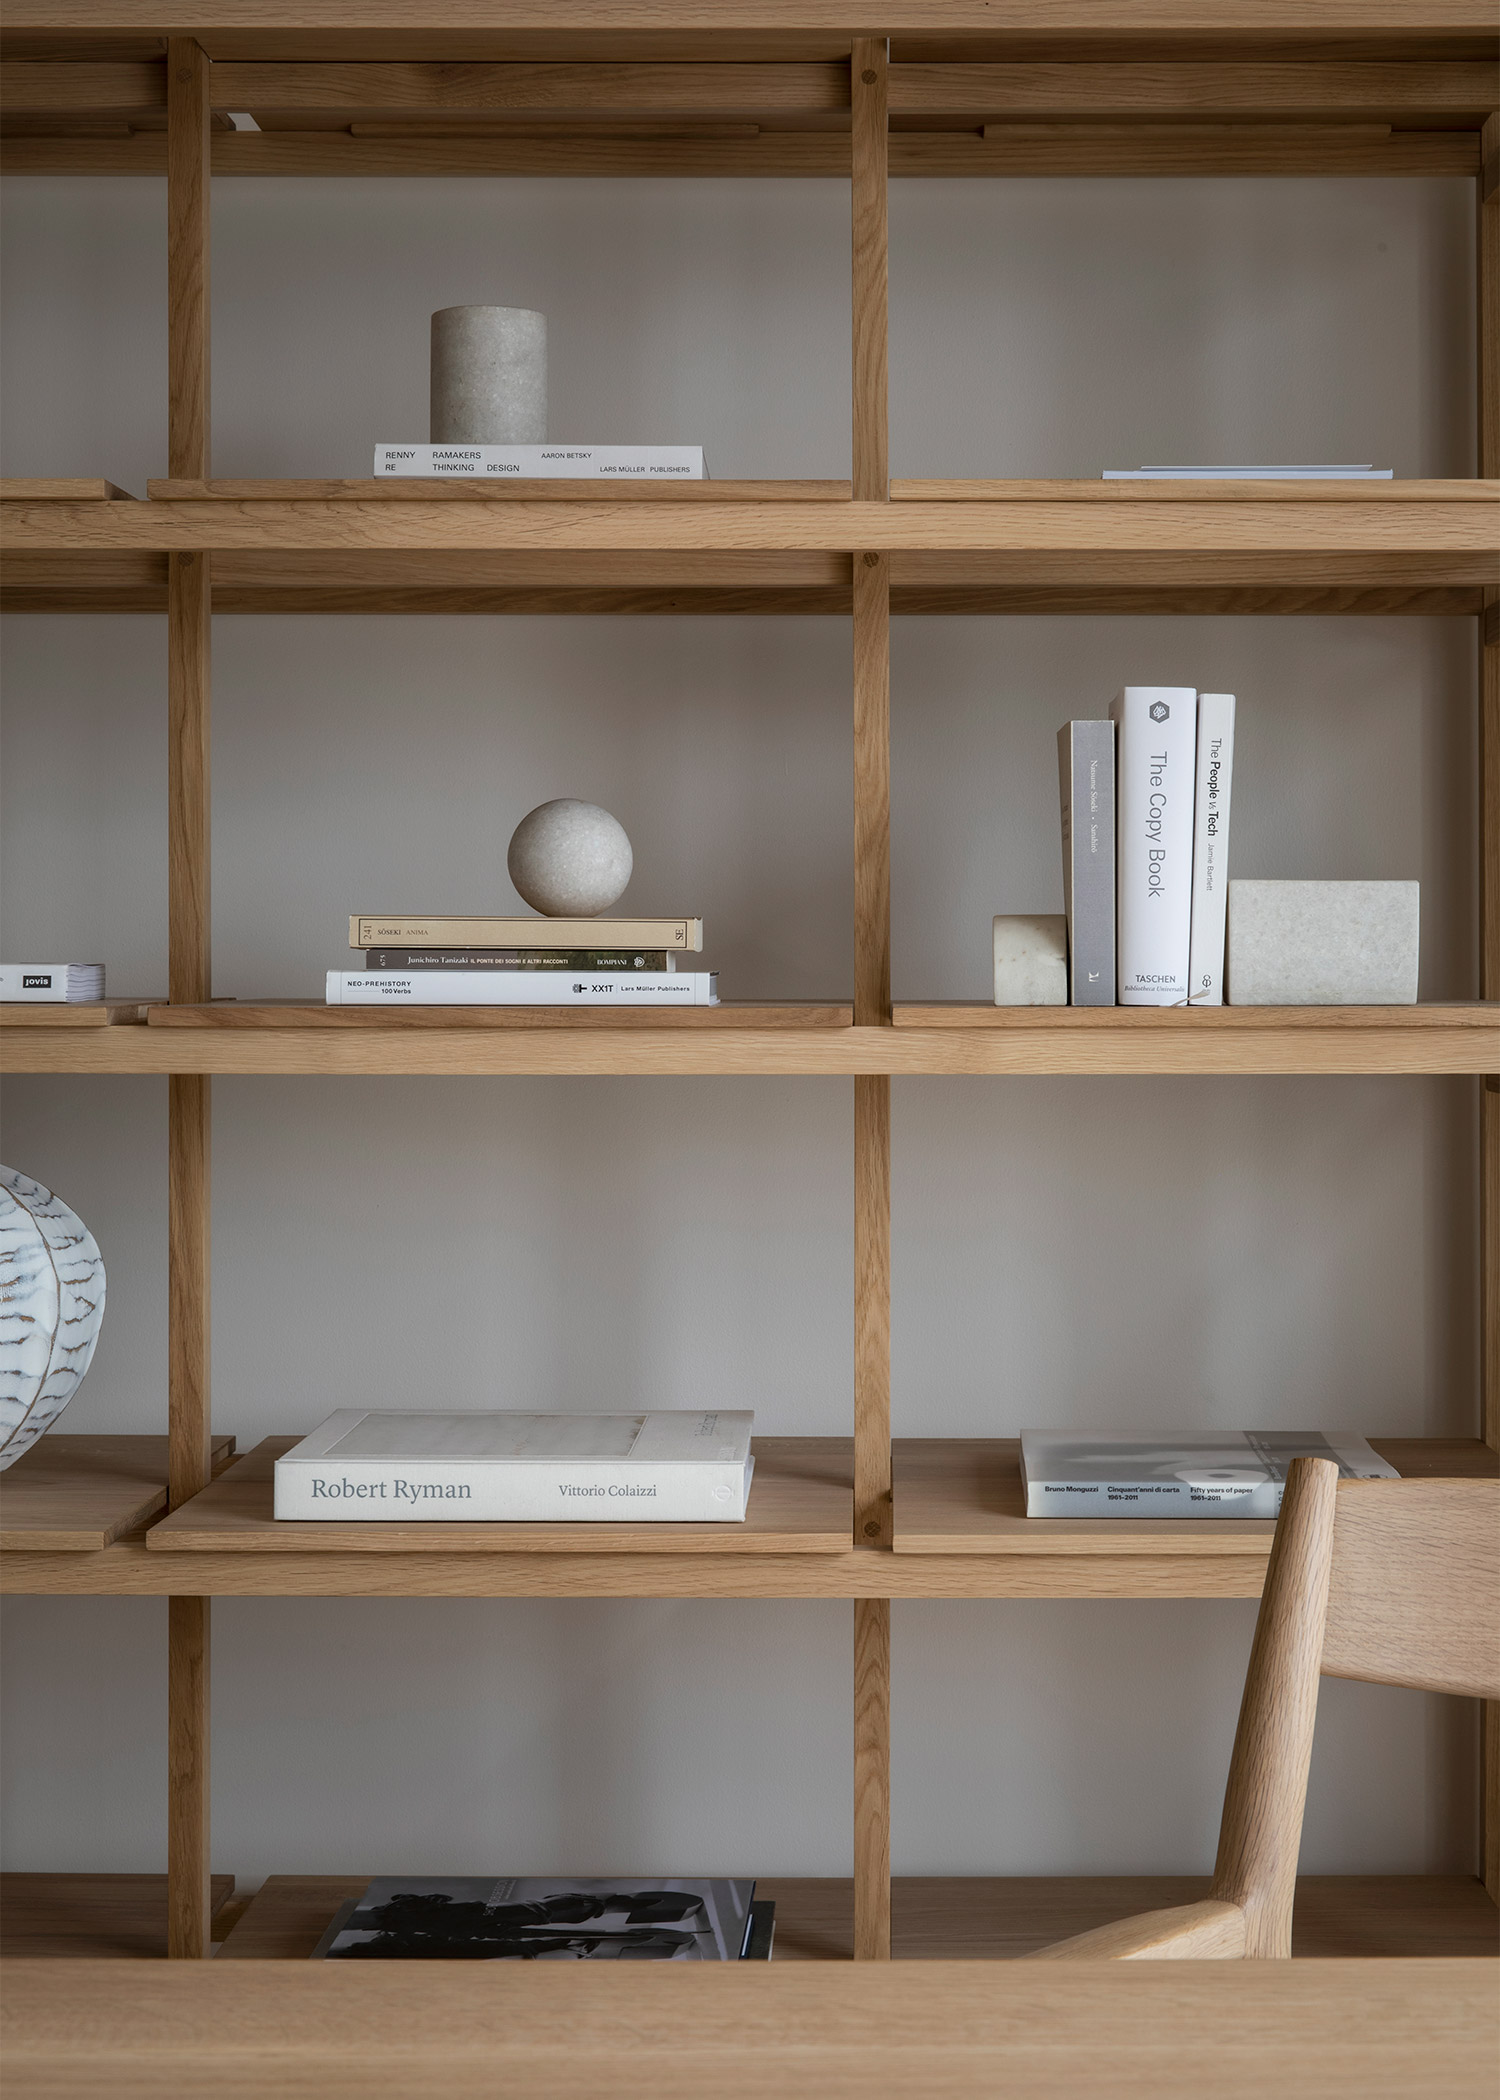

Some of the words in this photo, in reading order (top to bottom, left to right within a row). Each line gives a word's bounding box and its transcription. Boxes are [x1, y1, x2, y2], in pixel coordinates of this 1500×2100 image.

[432, 464, 475, 472] THINKING
[487, 464, 520, 472] DESIGN
[618, 465, 645, 473] MÜLLER
[1210, 738, 1222, 758] The
[1150, 751, 1168, 787] The
[1207, 761, 1221, 799] People
[1145, 793, 1167, 843] Copy
[1207, 811, 1219, 836] Tech
[1207, 843, 1215, 864] Jamie
[1148, 849, 1166, 897] Book
[1206, 866, 1214, 891] Bartlett
[363, 925, 372, 940] 241
[675, 929, 684, 941] SE
[407, 956, 439, 965] Junichiro
[25, 977, 49, 986] jovis
[1135, 974, 1176, 983] TASCHEN
[311, 1478, 388, 1499] Robert
[394, 1479, 472, 1504] Ryman
[558, 1484, 606, 1497] Vittorio
[608, 1484, 657, 1497] Colaizzi
[1066, 1486, 1099, 1494] Monguzzi
